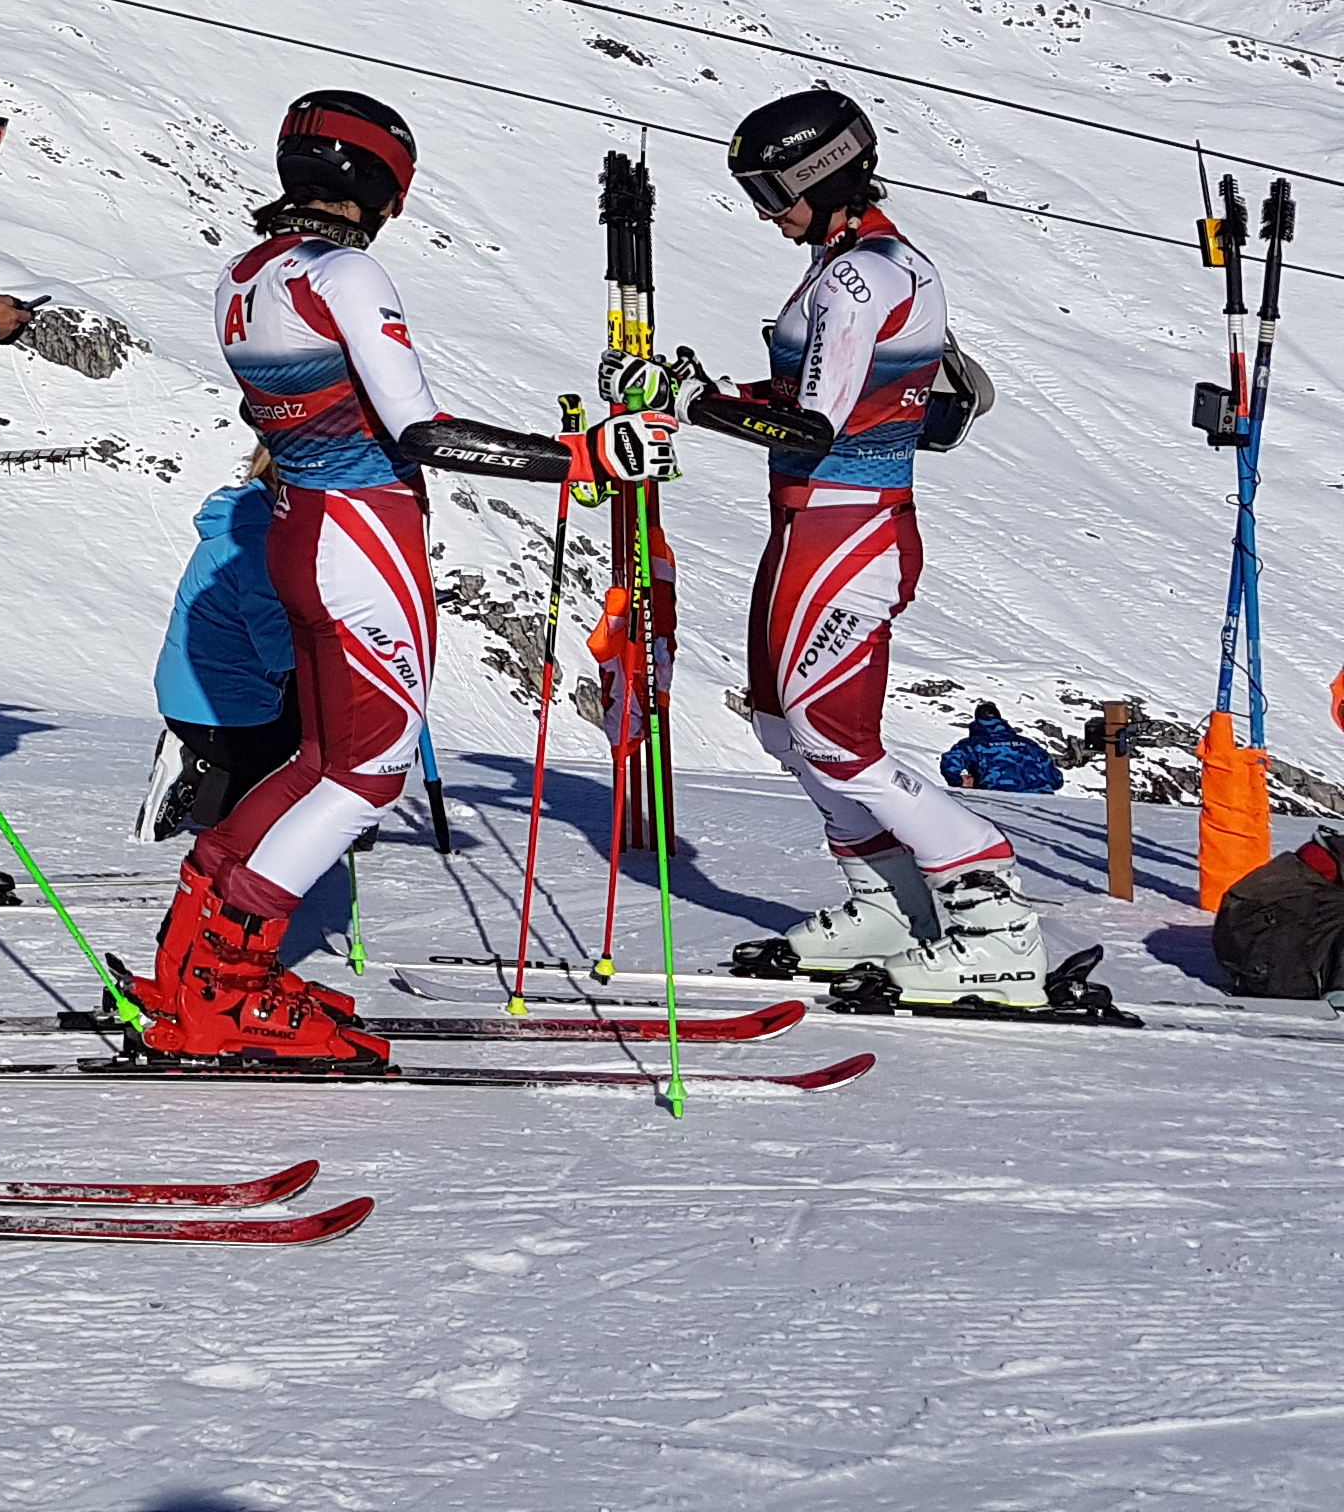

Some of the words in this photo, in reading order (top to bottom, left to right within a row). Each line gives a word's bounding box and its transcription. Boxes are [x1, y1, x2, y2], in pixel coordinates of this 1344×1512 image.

[781, 127, 817, 147] SMITH
[795, 141, 852, 181] SMITH
[224, 283, 257, 346] A1
[379, 307, 413, 350] A1
[806, 323, 827, 397] Schöffel
[743, 417, 787, 439] LEKI
[433, 446, 530, 469] DAINESE
[618, 426, 639, 472] reusch
[796, 608, 847, 679] POWER
[828, 614, 860, 657] TEAM
[361, 626, 419, 689] AUSTRIA
[853, 885, 896, 895] HEAD
[958, 971, 1036, 984] HEAD
[242, 1025, 297, 1040] ATOMIC
